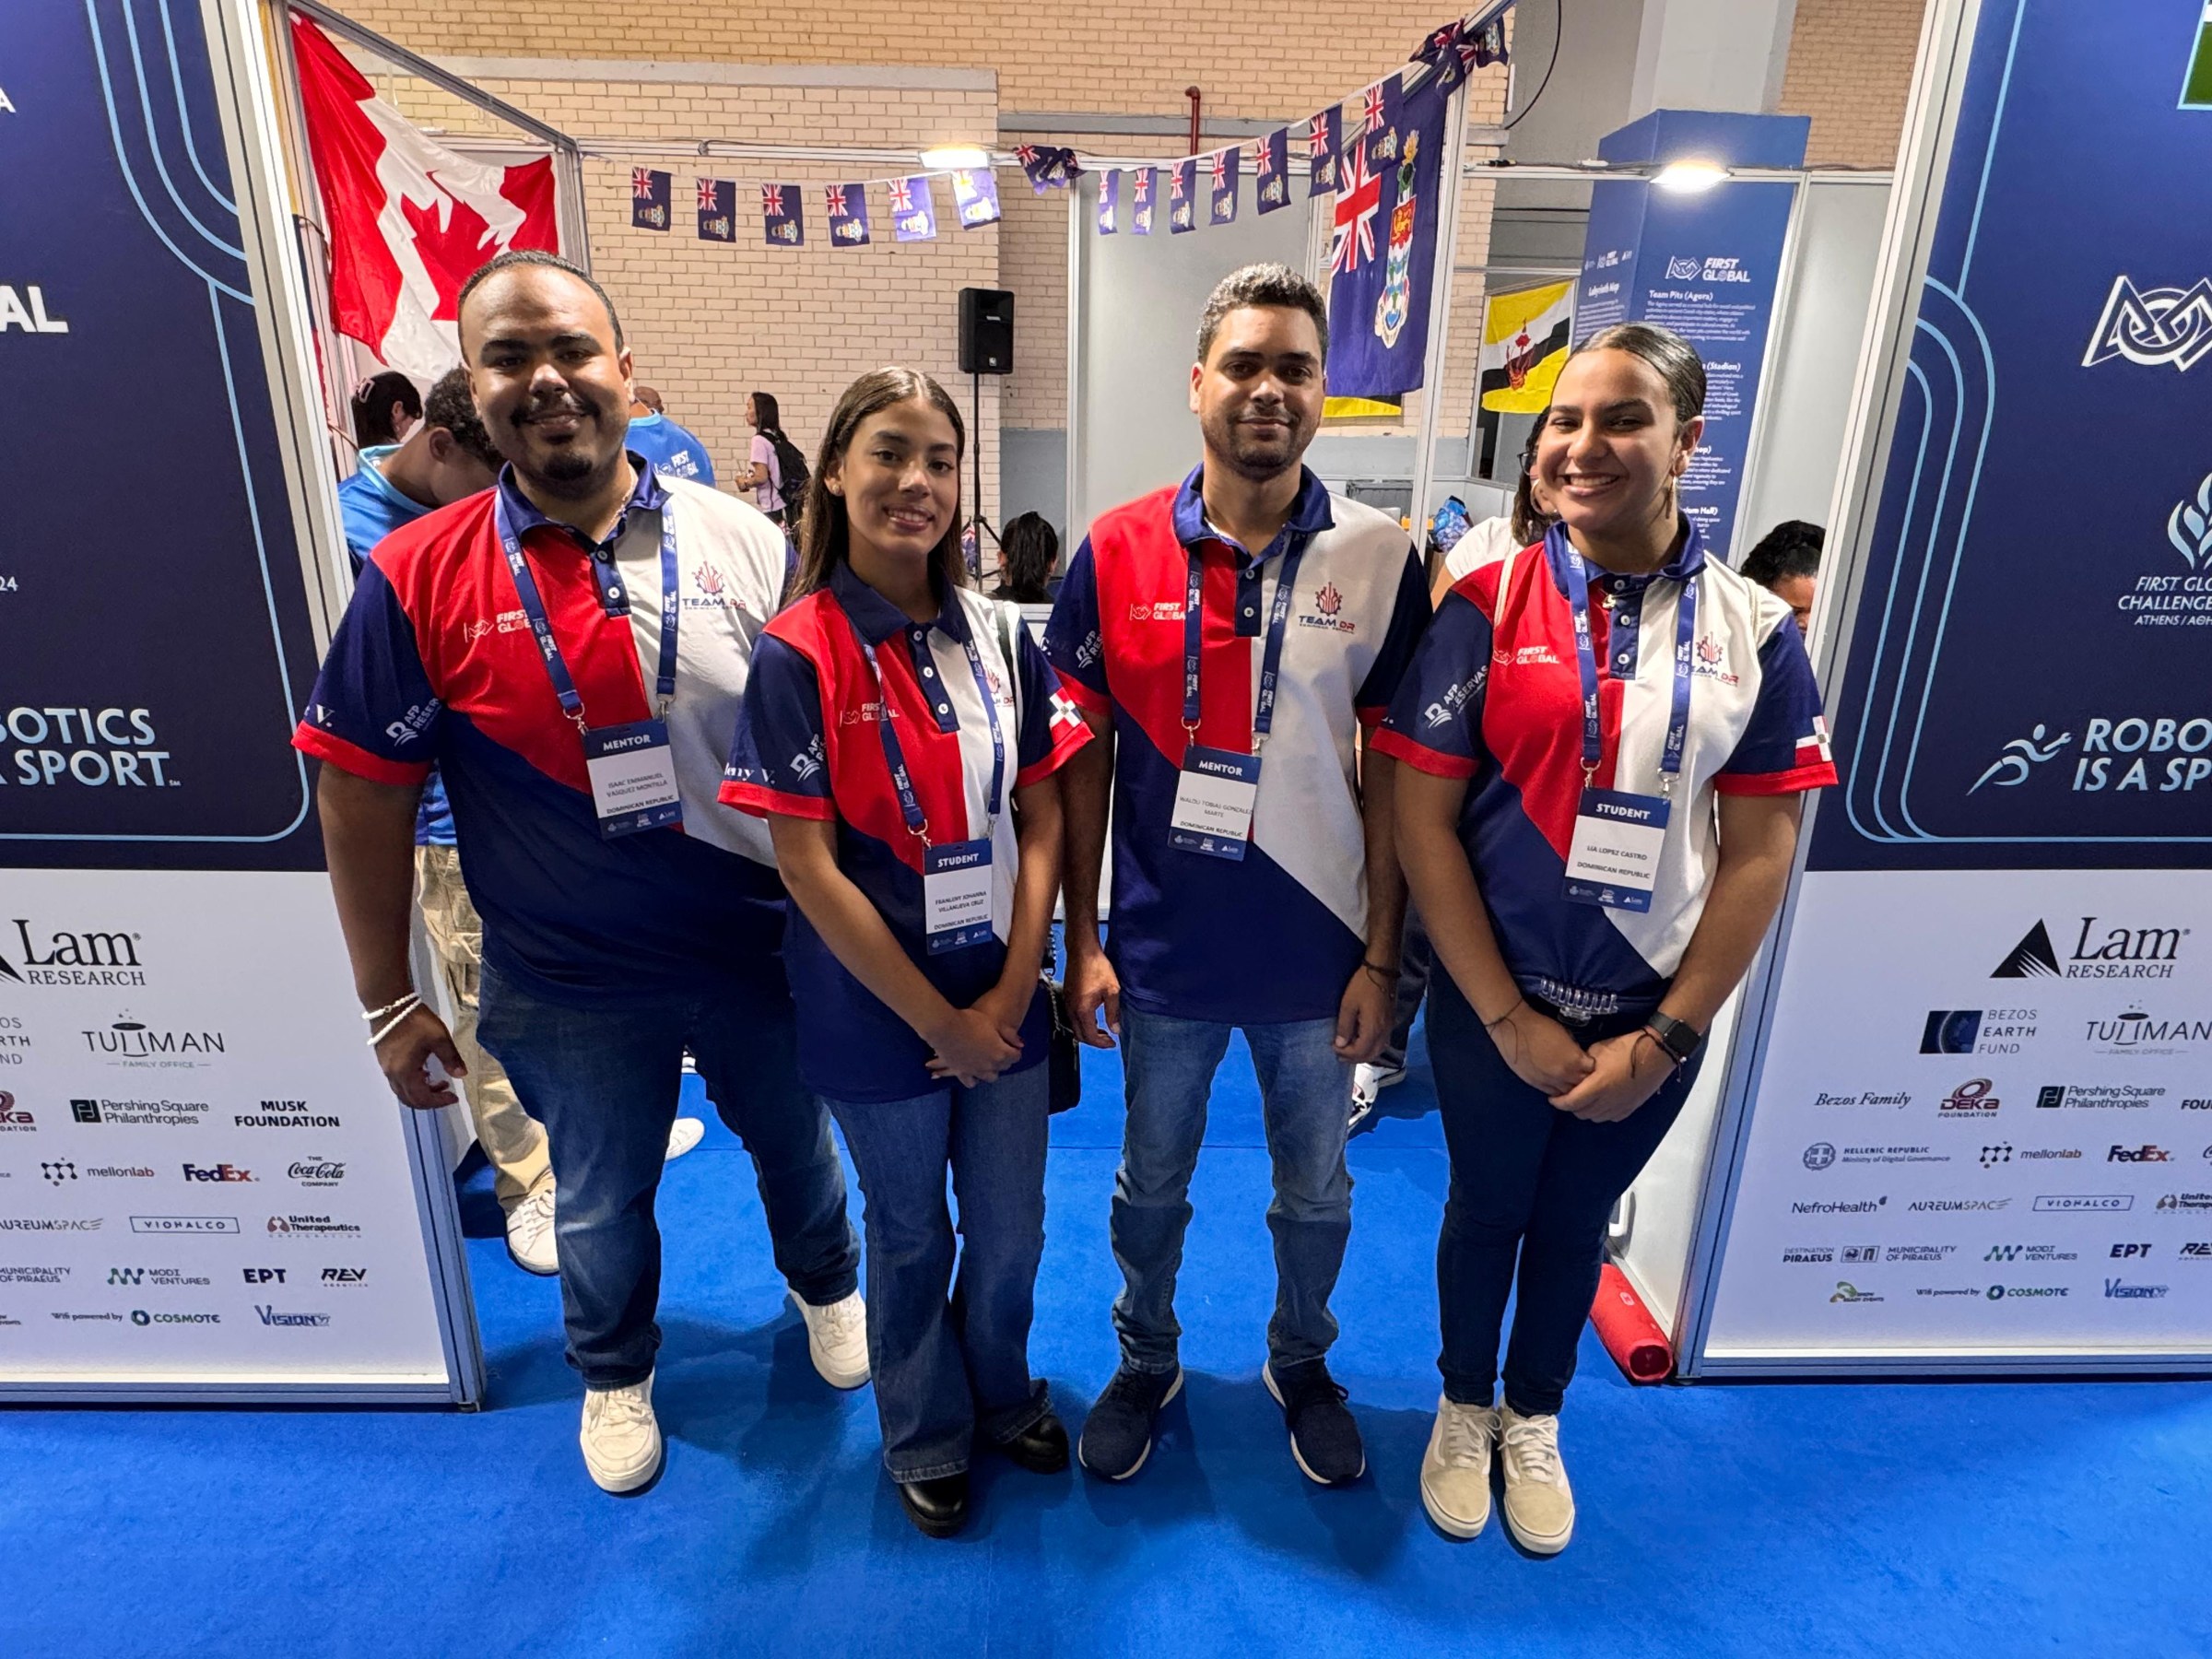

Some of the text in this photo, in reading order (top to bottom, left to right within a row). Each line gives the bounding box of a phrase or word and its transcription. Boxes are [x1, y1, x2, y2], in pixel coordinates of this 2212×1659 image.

[1704, 257, 1739, 269] FIRST
[1649, 289, 1667, 299] Team
[2135, 576, 2183, 591] FIRST
[682, 597, 725, 606] TEAM
[1153, 602, 1181, 611] FIRST
[2118, 595, 2212, 610] CHALLENGE
[1153, 611, 1185, 620] GLOBA
[2134, 615, 2181, 625] ATHENS
[1299, 615, 1336, 627] TEAM
[1339, 620, 1355, 631] DR
[1517, 646, 1547, 656] FIRST
[1443, 683, 1458, 705] AFP
[1452, 665, 1488, 710] ESERVAS
[861, 702, 880, 712] FIRS
[404, 704, 420, 724] AFP
[2083, 718, 2212, 753] ROBO
[603, 735, 652, 751] MENTOR
[15, 749, 170, 786] SPORT
[1198, 760, 1243, 776] MENTOR
[2072, 758, 2112, 791] IS
[2116, 758, 2148, 791] A
[1596, 803, 1651, 819] STUDENT
[937, 853, 979, 867] STUDENT
[12, 920, 142, 966] Lam
[2069, 917, 2181, 960] Lam
[27, 970, 147, 985] RESEARCH
[2065, 964, 2173, 978] RESEARCH
[1987, 1009, 2038, 1020] BEZOS
[1983, 1027, 2037, 1037] EARTH
[1979, 1043, 2020, 1054] FUND
[2067, 1086, 2165, 1098] Pershing Square
[261, 1100, 309, 1112] MUSK
[1814, 1091, 1912, 1109] Bezos Family
[2064, 1098, 2149, 1111] Philanthropies
[2181, 1100, 2212, 1110] FOU
[101, 1100, 209, 1114] Pershing Square
[104, 1112, 199, 1126] Philanthropies
[235, 1115, 340, 1127] FOUNDATION
[2020, 1149, 2082, 1159] mellonlab
[2107, 1145, 2171, 1162] FedEx
[87, 1167, 155, 1177] mellonlab
[182, 1163, 253, 1182] FedEx
[1792, 1201, 1877, 1214] NefroHealth
[290, 1224, 360, 1233] Therapeutics
[2180, 1243, 2212, 1254] RE
[1783, 1254, 1832, 1263] PIRAEUS
[321, 1268, 367, 1281] REV
